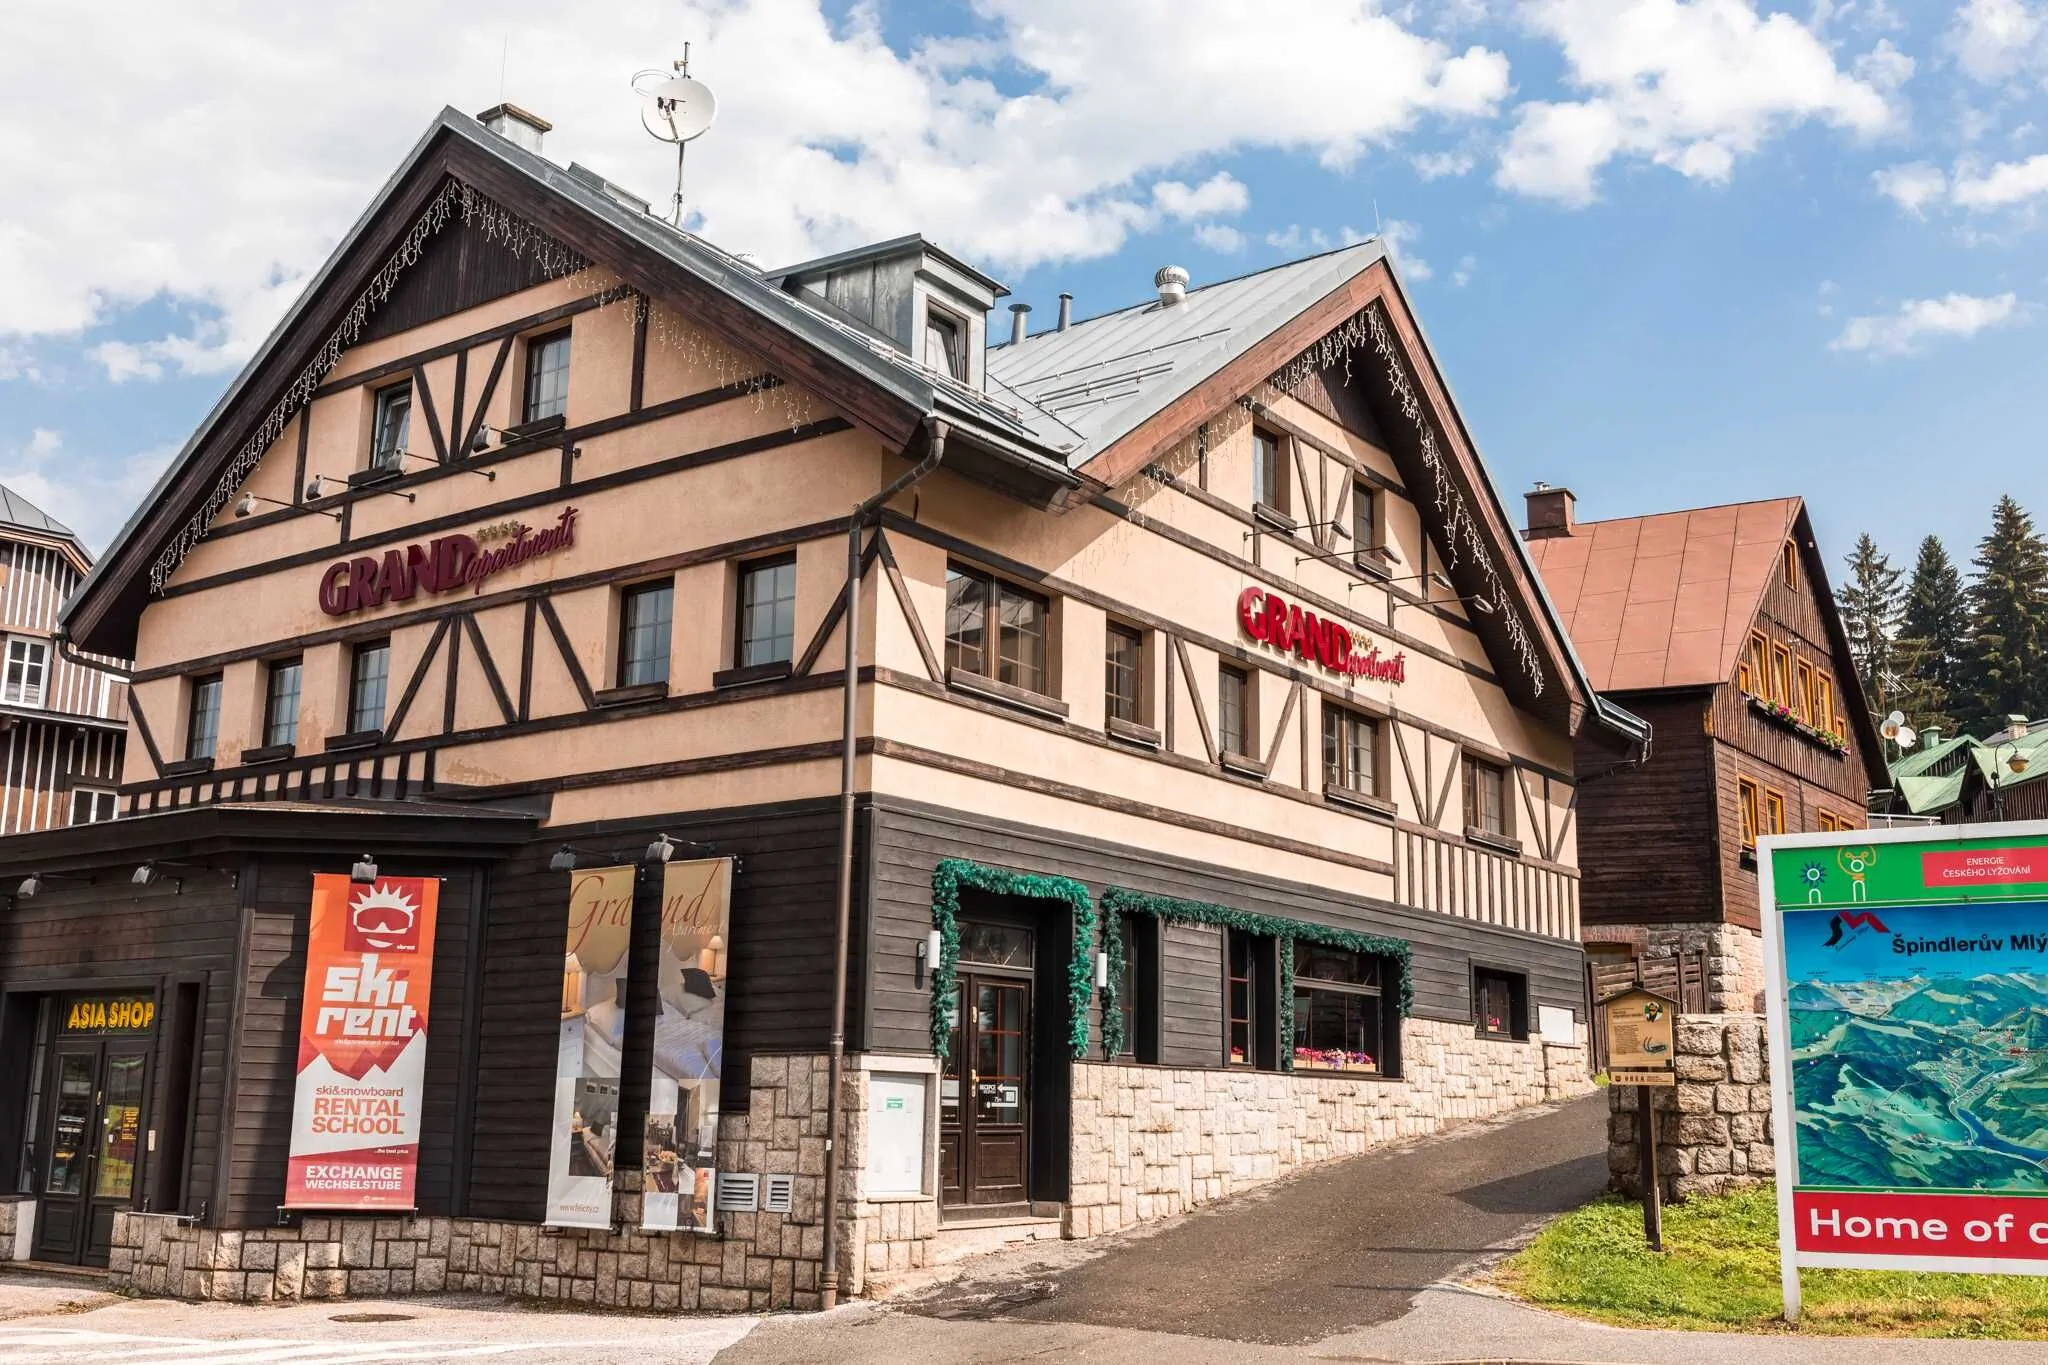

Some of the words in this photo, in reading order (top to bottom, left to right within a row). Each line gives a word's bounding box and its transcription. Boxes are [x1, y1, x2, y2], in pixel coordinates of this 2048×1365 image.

[319, 533, 479, 617] GRAND
[465, 506, 579, 595] apartments
[1239, 586, 1352, 673] GRAND
[1943, 867, 1985, 878] ČESKÉHO
[1987, 864, 2031, 877] LYŽOVÁNÍ
[1966, 856, 2005, 866] ENERGIE
[1892, 933, 2003, 957] Špindlerův
[322, 952, 410, 1007] ski
[68, 1003, 106, 1029] ASIA
[107, 1001, 154, 1029] SHOP
[315, 1004, 417, 1037] rent
[315, 1085, 404, 1097] ski&snowboard
[313, 1098, 406, 1116] RENTAL
[311, 1116, 405, 1134] SCHOOL
[305, 1165, 403, 1180] EXCHANGE
[304, 1179, 402, 1191] WECHSELSTUBE
[1810, 1207, 1948, 1241] Home
[1963, 1213, 2014, 1243] of
